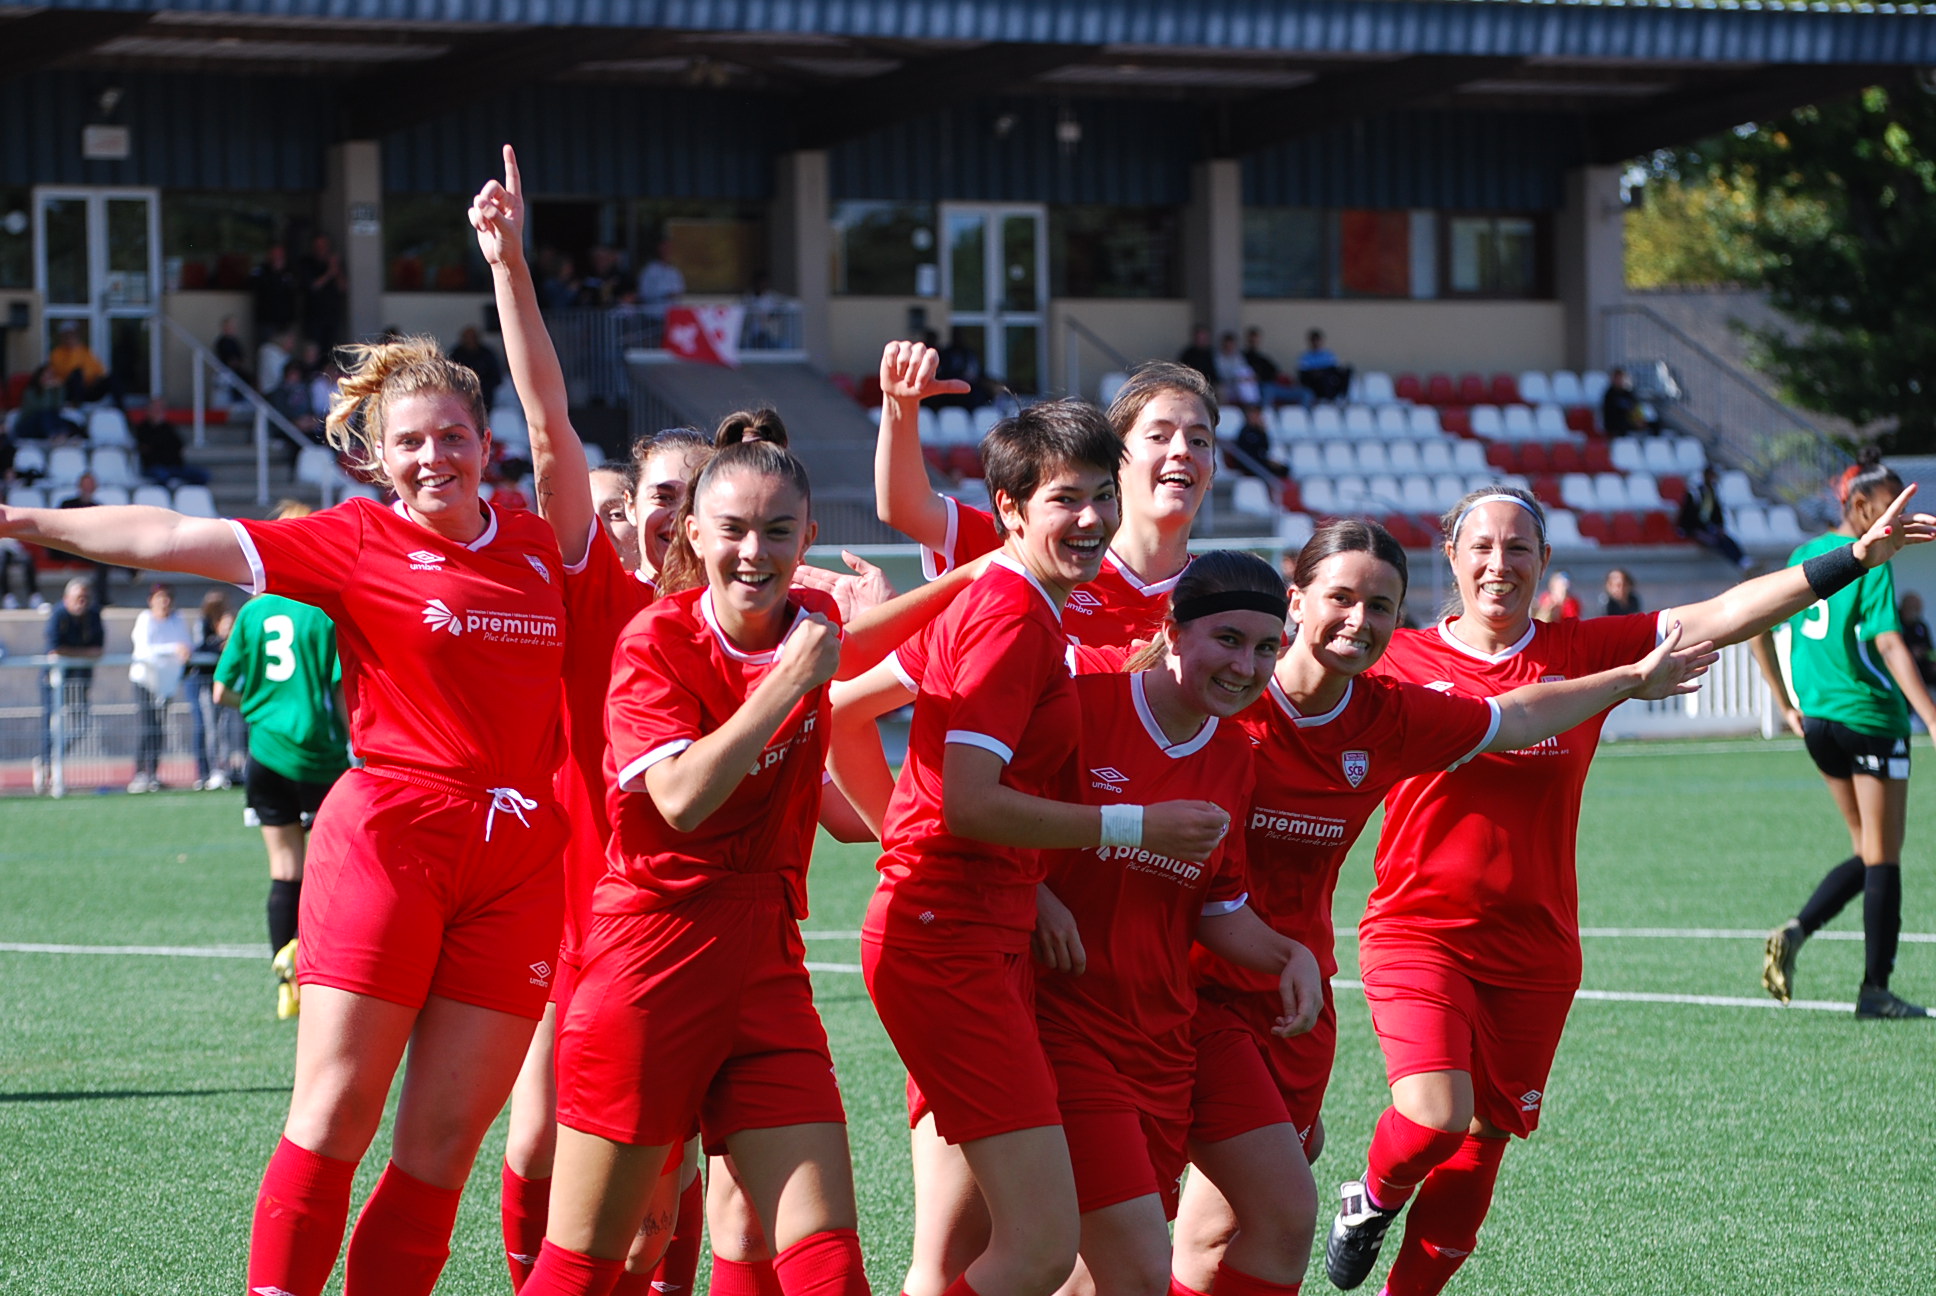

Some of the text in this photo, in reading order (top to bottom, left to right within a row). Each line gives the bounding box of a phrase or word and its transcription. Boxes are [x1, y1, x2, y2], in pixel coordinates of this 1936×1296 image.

[409, 562, 442, 571] umbro
[1065, 601, 1093, 615] umbro
[467, 615, 556, 637] premium
[263, 614, 296, 682] 3
[1347, 765, 1365, 777] SCB
[1091, 780, 1122, 794] umbro
[1251, 812, 1344, 838] premium
[1114, 845, 1201, 880] premium
